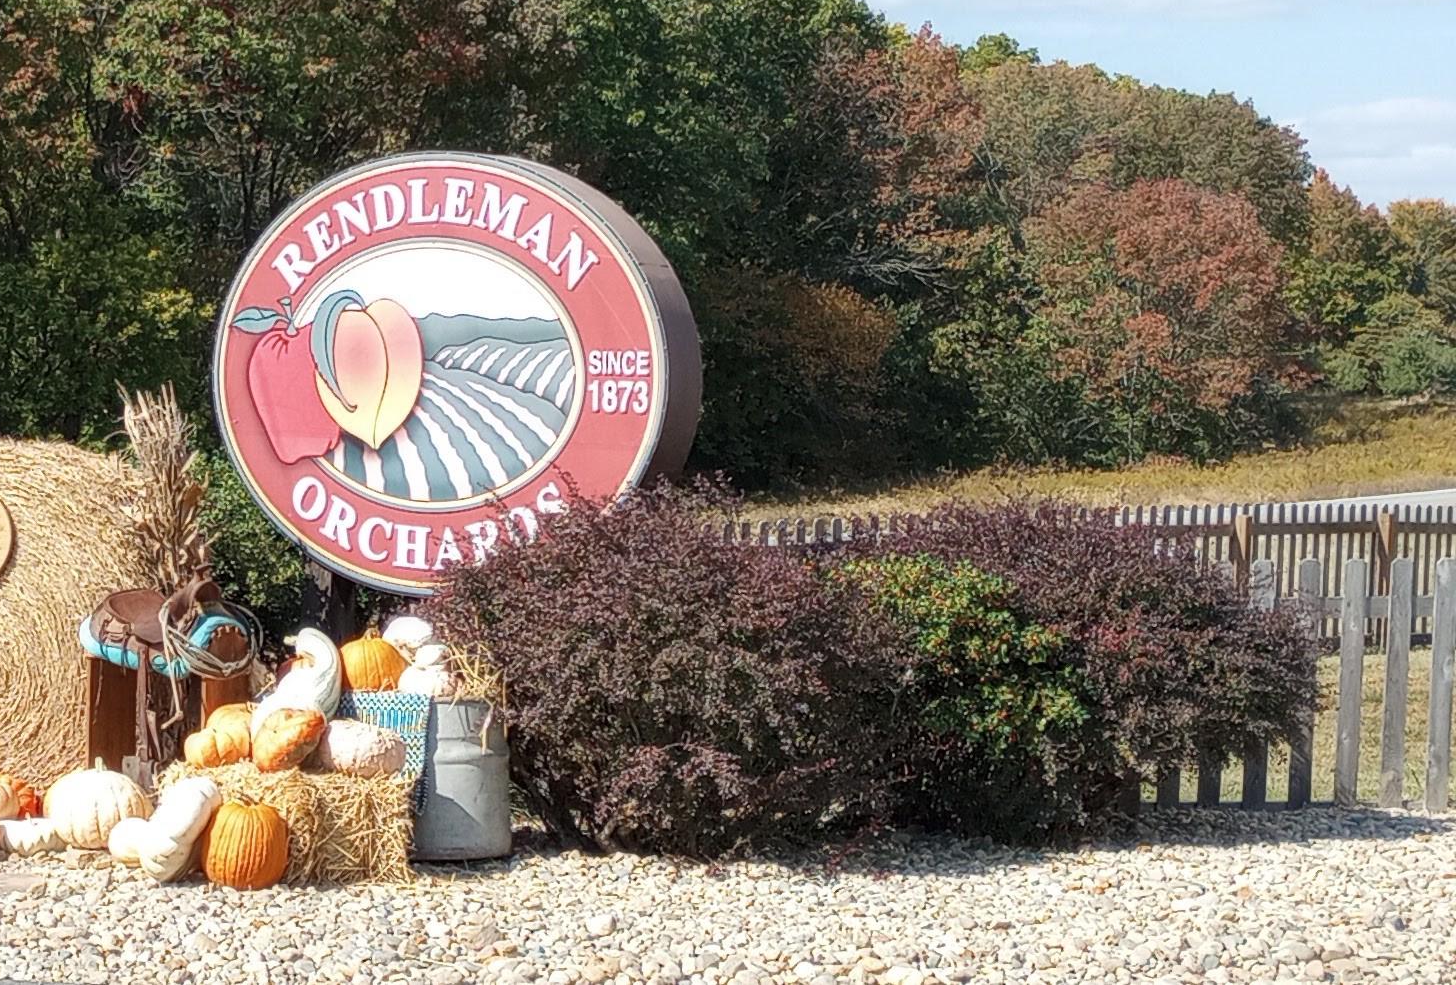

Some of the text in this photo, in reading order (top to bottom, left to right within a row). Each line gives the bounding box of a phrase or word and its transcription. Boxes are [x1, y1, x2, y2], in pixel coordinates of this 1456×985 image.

[270, 177, 601, 294] RENDLEMAN
[588, 350, 651, 375] SINCE
[588, 381, 650, 414] 1873
